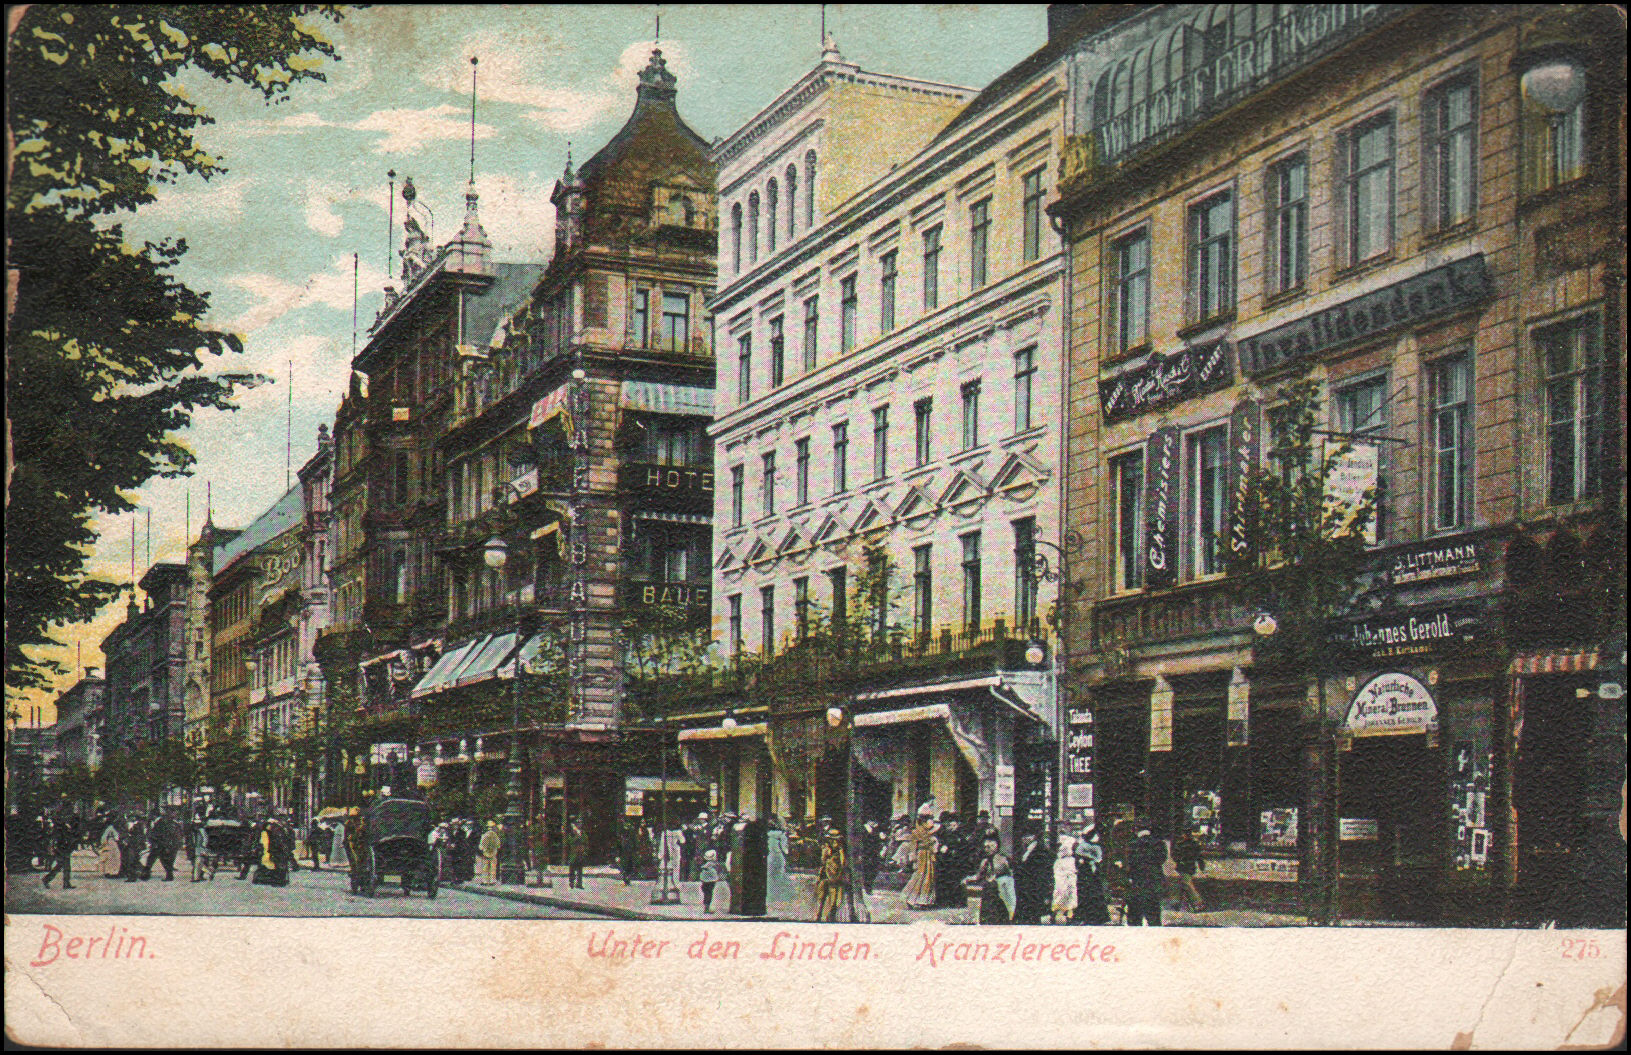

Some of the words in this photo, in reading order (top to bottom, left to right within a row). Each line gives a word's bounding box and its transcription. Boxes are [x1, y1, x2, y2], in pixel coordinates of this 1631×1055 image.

[1231, 416, 1252, 552] Shirtmaker
[1150, 433, 1173, 570] Chemisiers
[1407, 544, 1476, 568] LITTMANN
[1409, 612, 1454, 641] Gerold.
[1069, 754, 1092, 773] THEE
